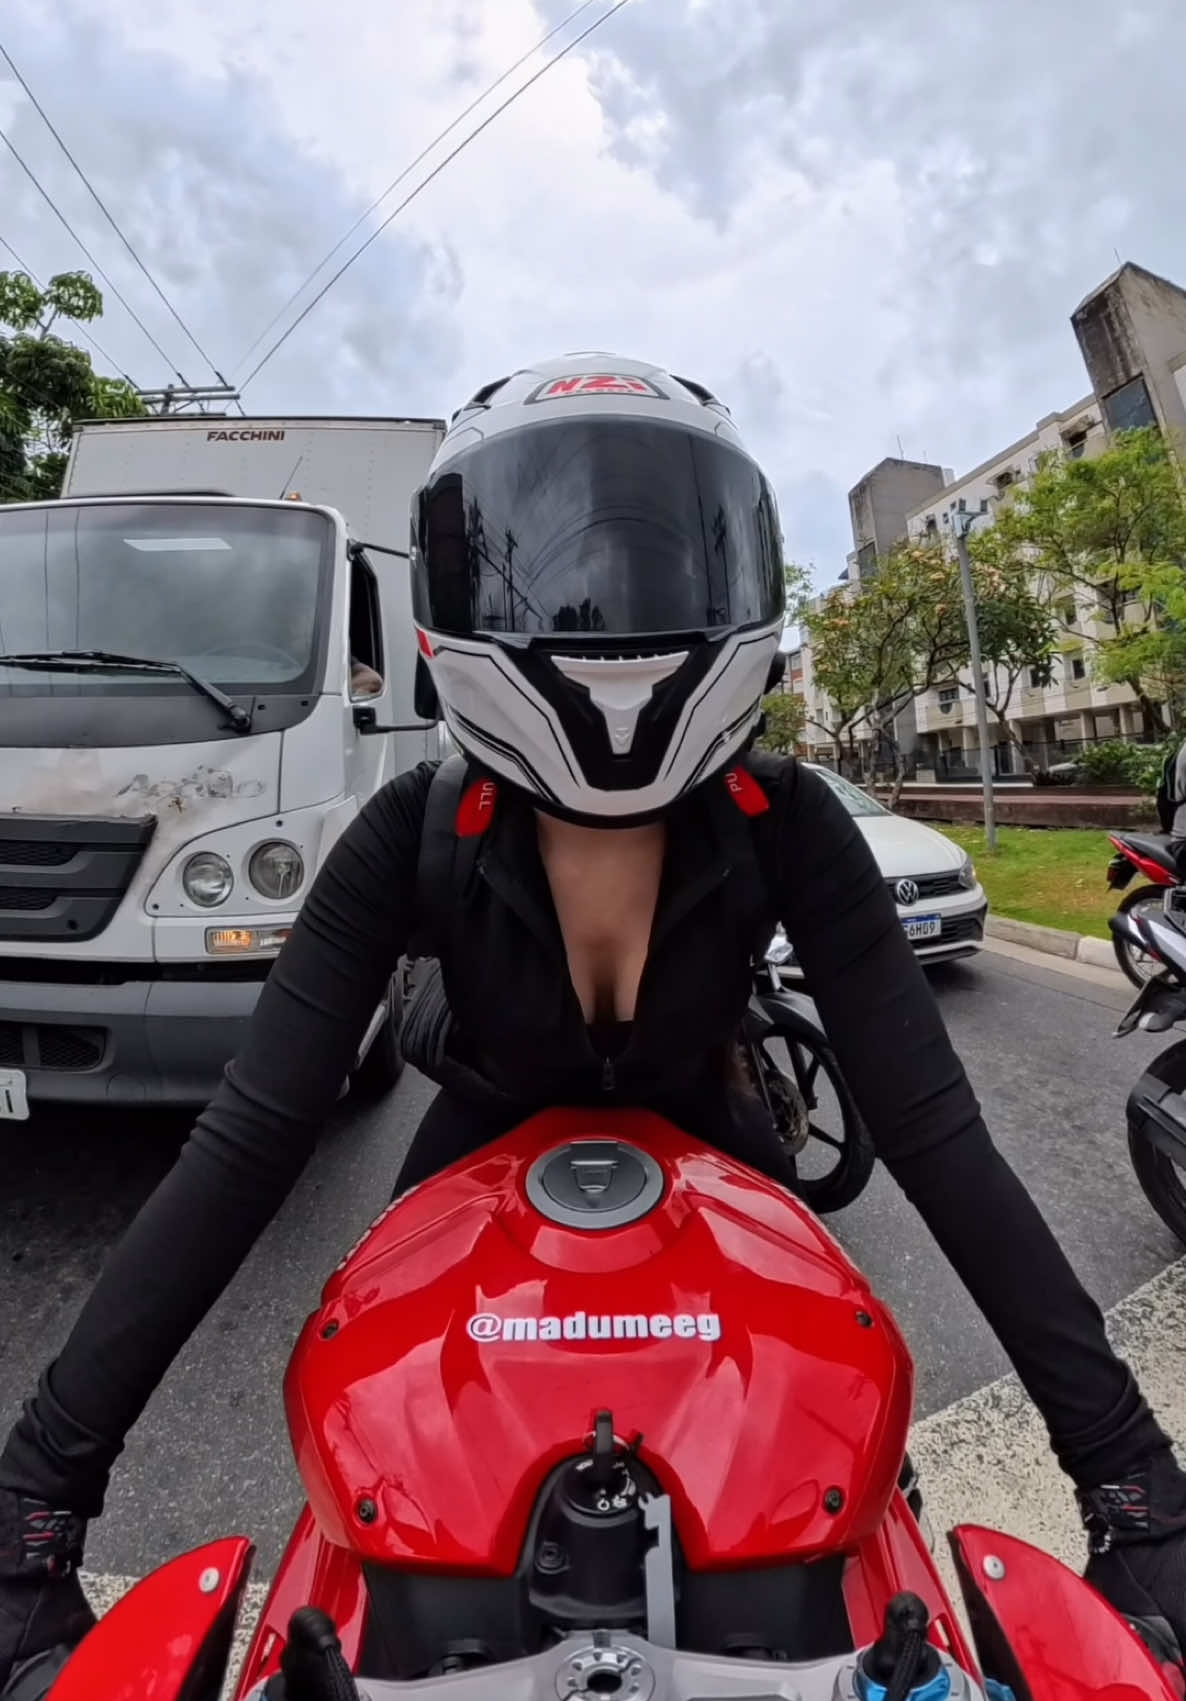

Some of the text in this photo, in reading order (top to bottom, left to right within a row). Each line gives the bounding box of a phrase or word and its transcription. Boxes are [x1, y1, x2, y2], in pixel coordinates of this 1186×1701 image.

[206, 430, 285, 442] FACCHINI
[725, 772, 743, 793] PU
[478, 782, 496, 811] ULL
[467, 1311, 721, 1342] @madumeeg
